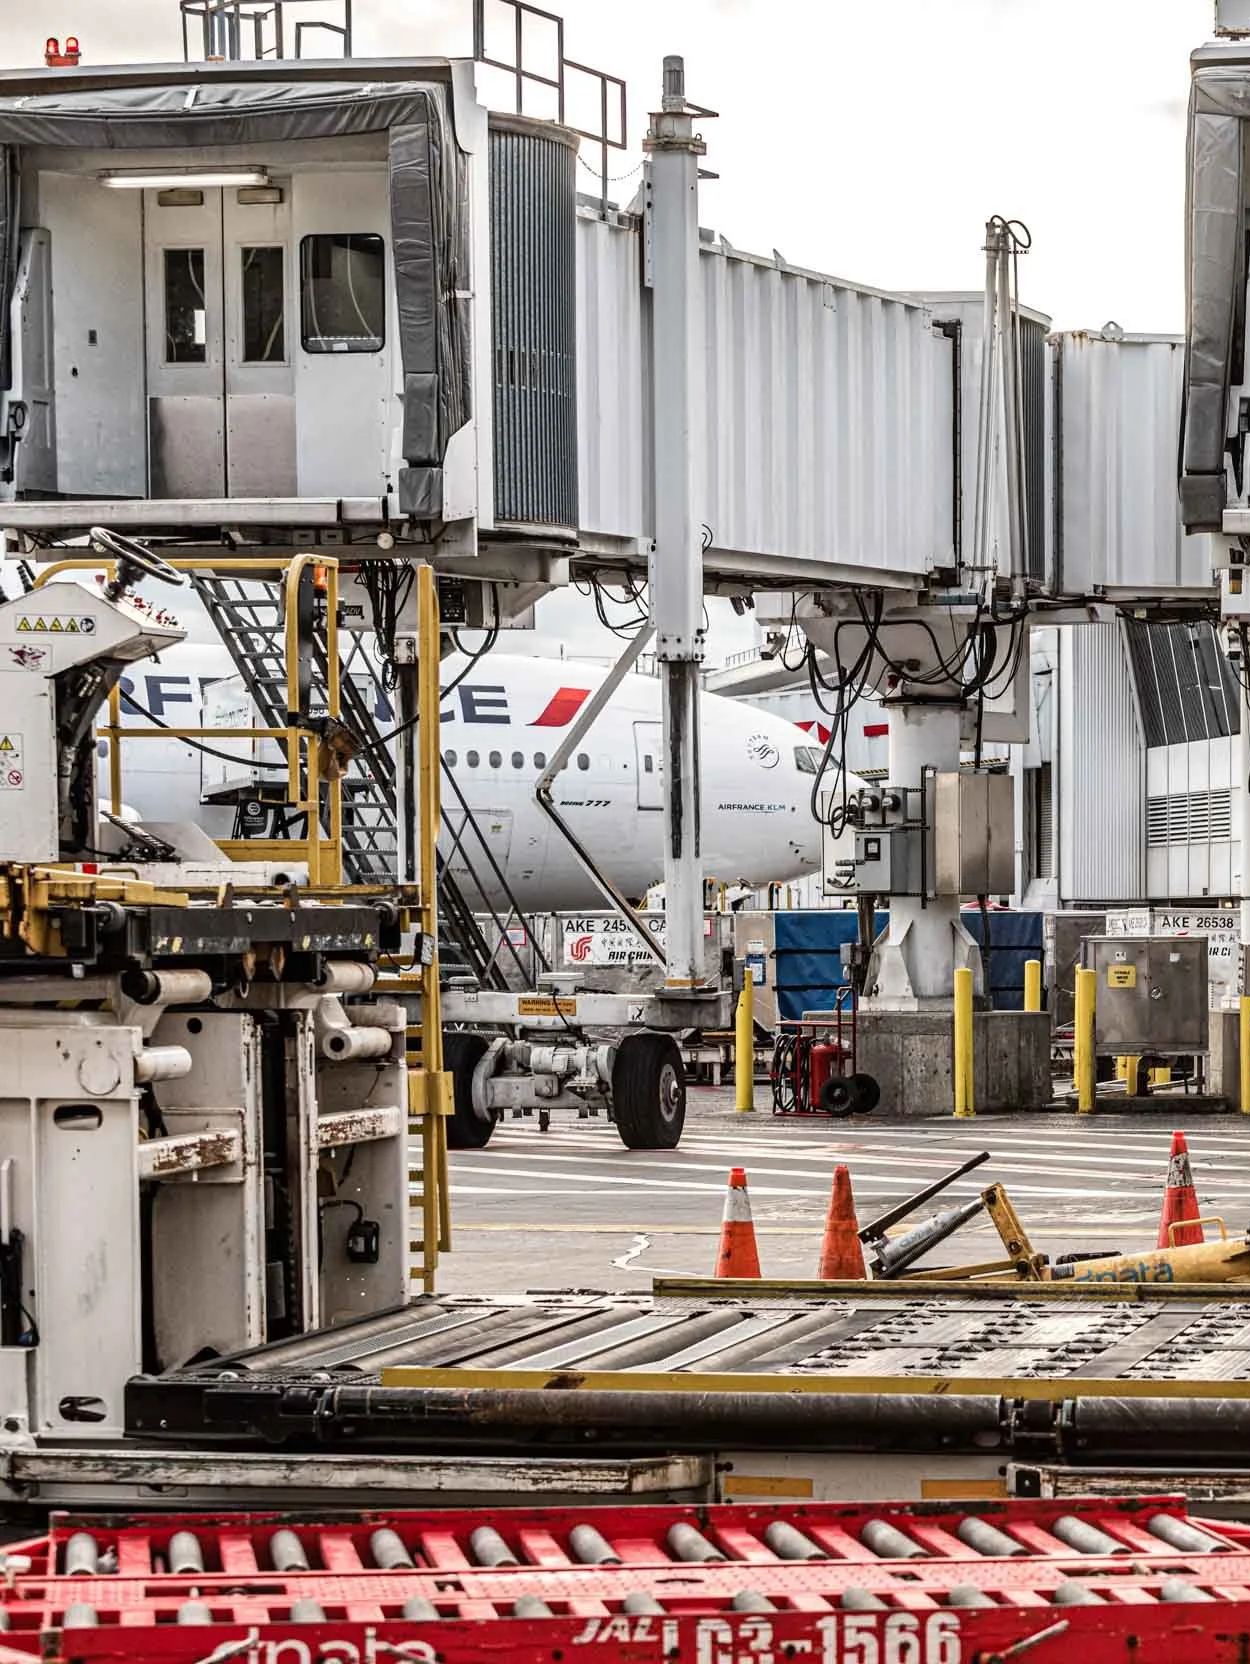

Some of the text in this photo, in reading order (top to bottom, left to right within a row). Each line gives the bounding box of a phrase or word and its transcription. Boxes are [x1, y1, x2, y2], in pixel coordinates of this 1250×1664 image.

[718, 803, 786, 811] AIRFRANCE KLM
[565, 920, 595, 932] AKE
[603, 920, 632, 932] 245
[1162, 916, 1234, 928] AKE 26538
[608, 951, 626, 960] AIR
[572, 1617, 660, 1644] JAL
